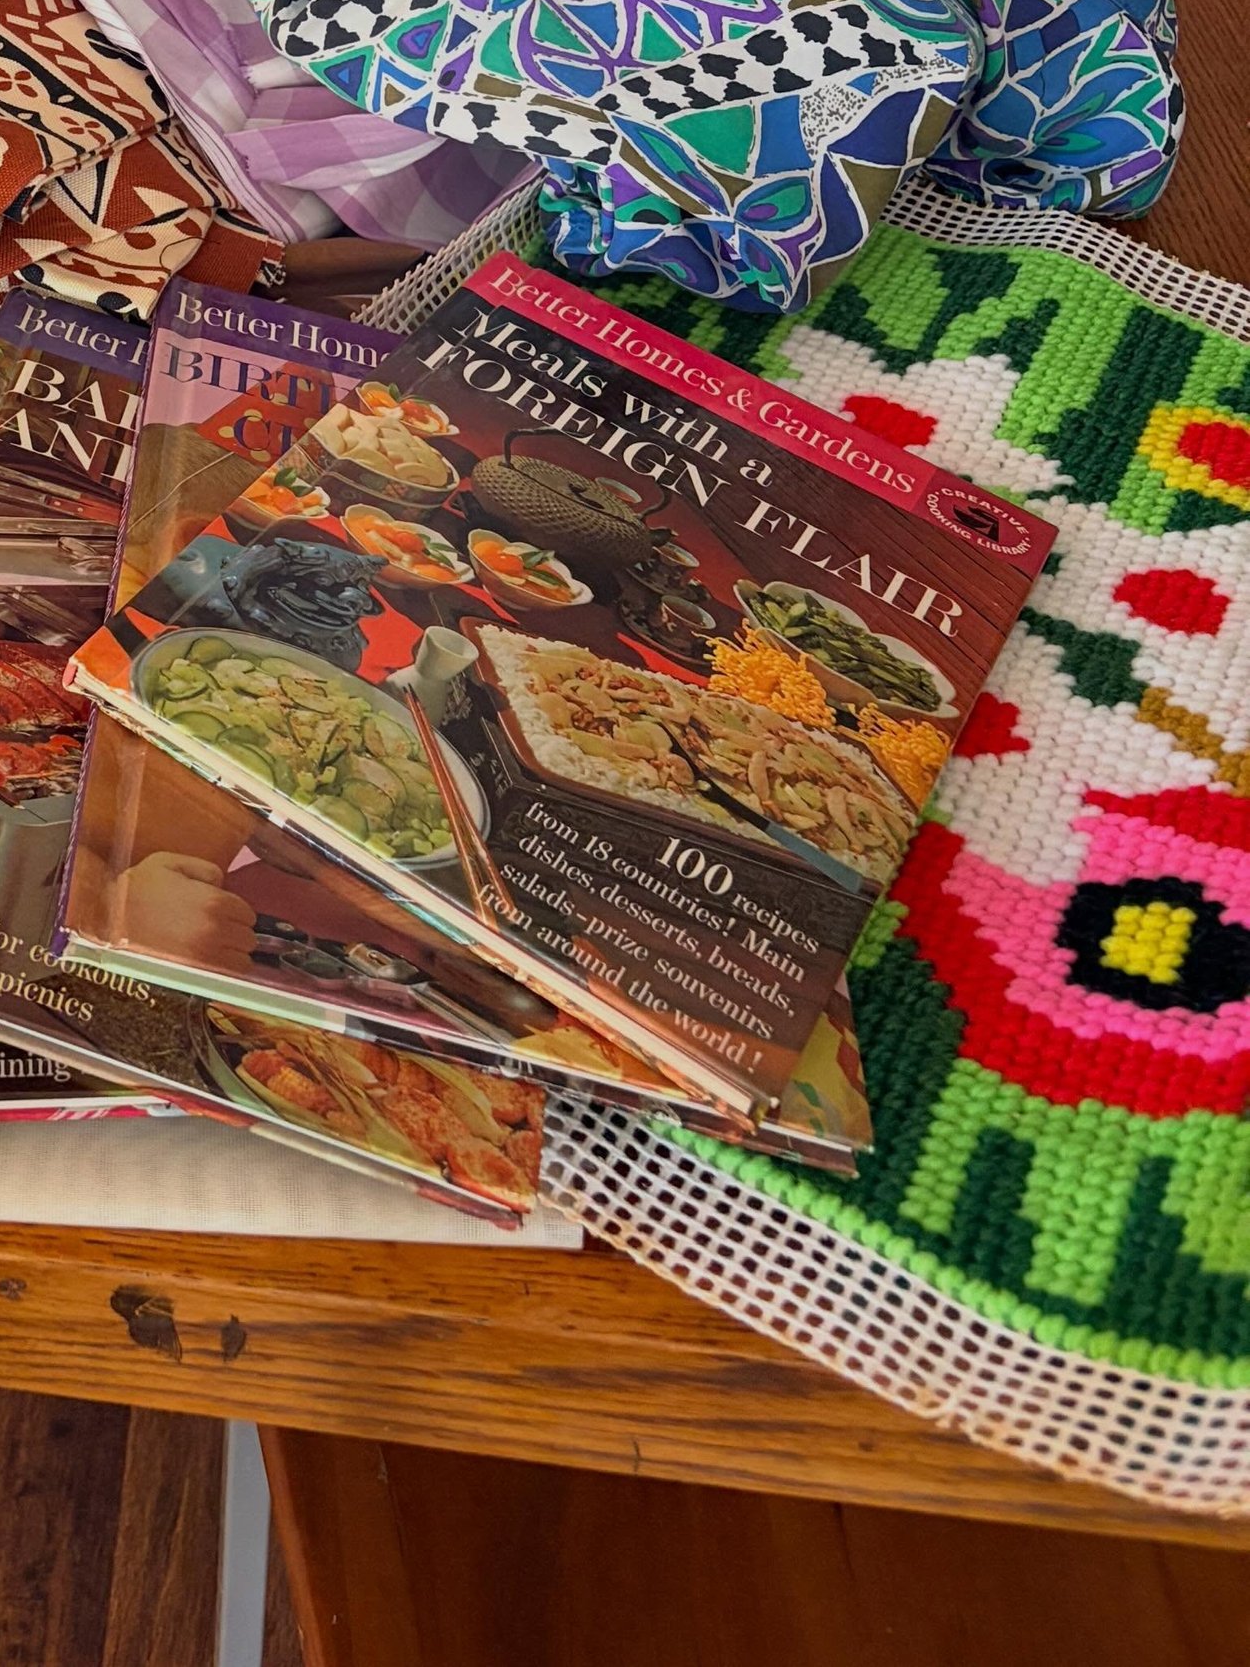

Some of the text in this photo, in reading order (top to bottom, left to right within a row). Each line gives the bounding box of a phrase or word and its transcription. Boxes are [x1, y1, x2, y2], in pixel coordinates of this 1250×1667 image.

[15, 303, 127, 358] Better
[173, 291, 283, 343] Better
[452, 306, 773, 488] Meals with a
[489, 267, 917, 494] Better Homes & Gardens
[416, 335, 963, 638] FOREIGN FLAIR
[926, 493, 1031, 555] COOKING LIBRARY
[941, 488, 1029, 535] CREATIVE
[477, 883, 533, 932] from
[536, 927, 627, 987] around
[627, 977, 670, 1015] the
[518, 835, 796, 1018] dishes, desserts, breads,
[524, 801, 806, 983] from 18 countries! Main
[654, 836, 820, 956] 100 recipes
[654, 955, 775, 1041] souvenirs
